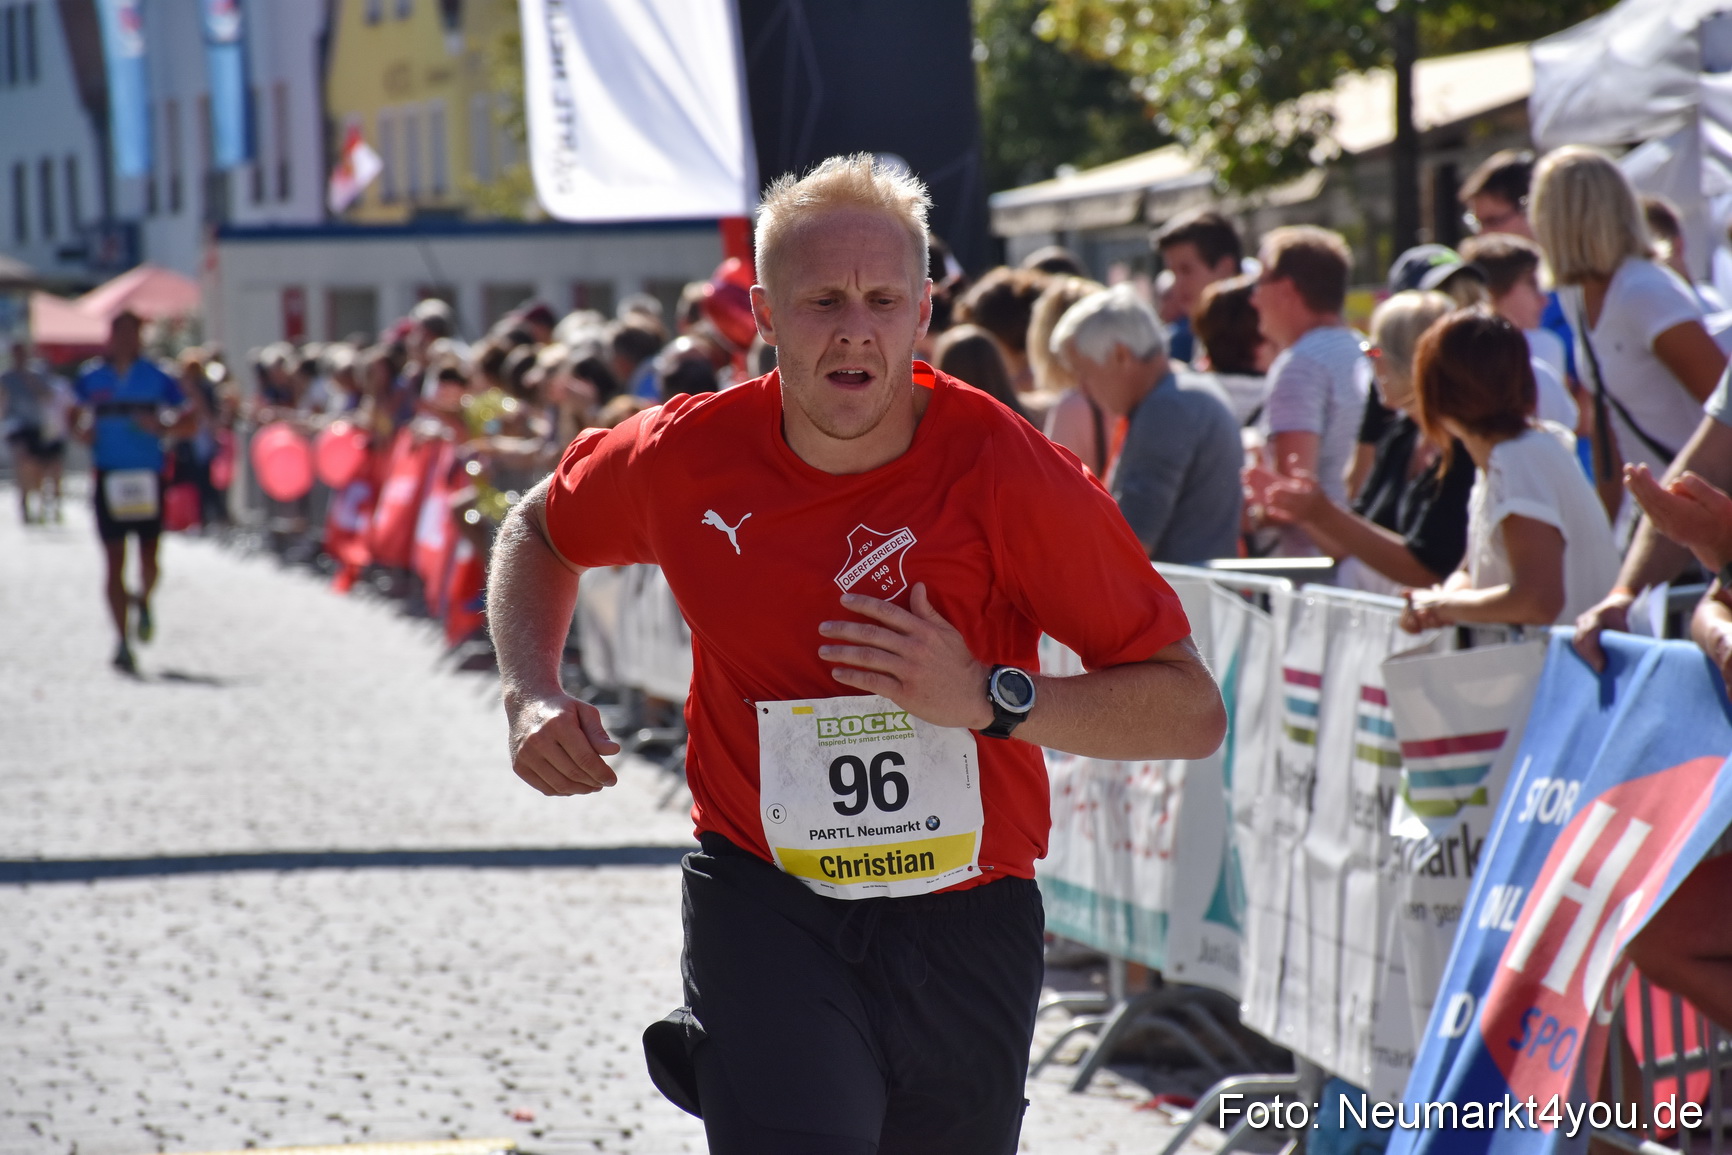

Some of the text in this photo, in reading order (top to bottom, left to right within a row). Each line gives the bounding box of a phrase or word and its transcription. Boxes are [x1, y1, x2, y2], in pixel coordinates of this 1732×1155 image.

[858, 540, 873, 556] FSV
[842, 533, 909, 586] OBERFERRIEDEN
[871, 565, 890, 582] 1949
[881, 576, 896, 591] e.V.
[817, 711, 913, 738] BOCK
[818, 739, 846, 747] inspired
[859, 735, 880, 743] smart
[882, 732, 915, 741] concepts
[829, 751, 910, 817] 96
[772, 808, 780, 820] C
[809, 827, 855, 840] PARTL
[858, 821, 921, 837] Neumarkt
[819, 850, 935, 879] Christian
[1508, 1006, 1578, 1078] SPO
